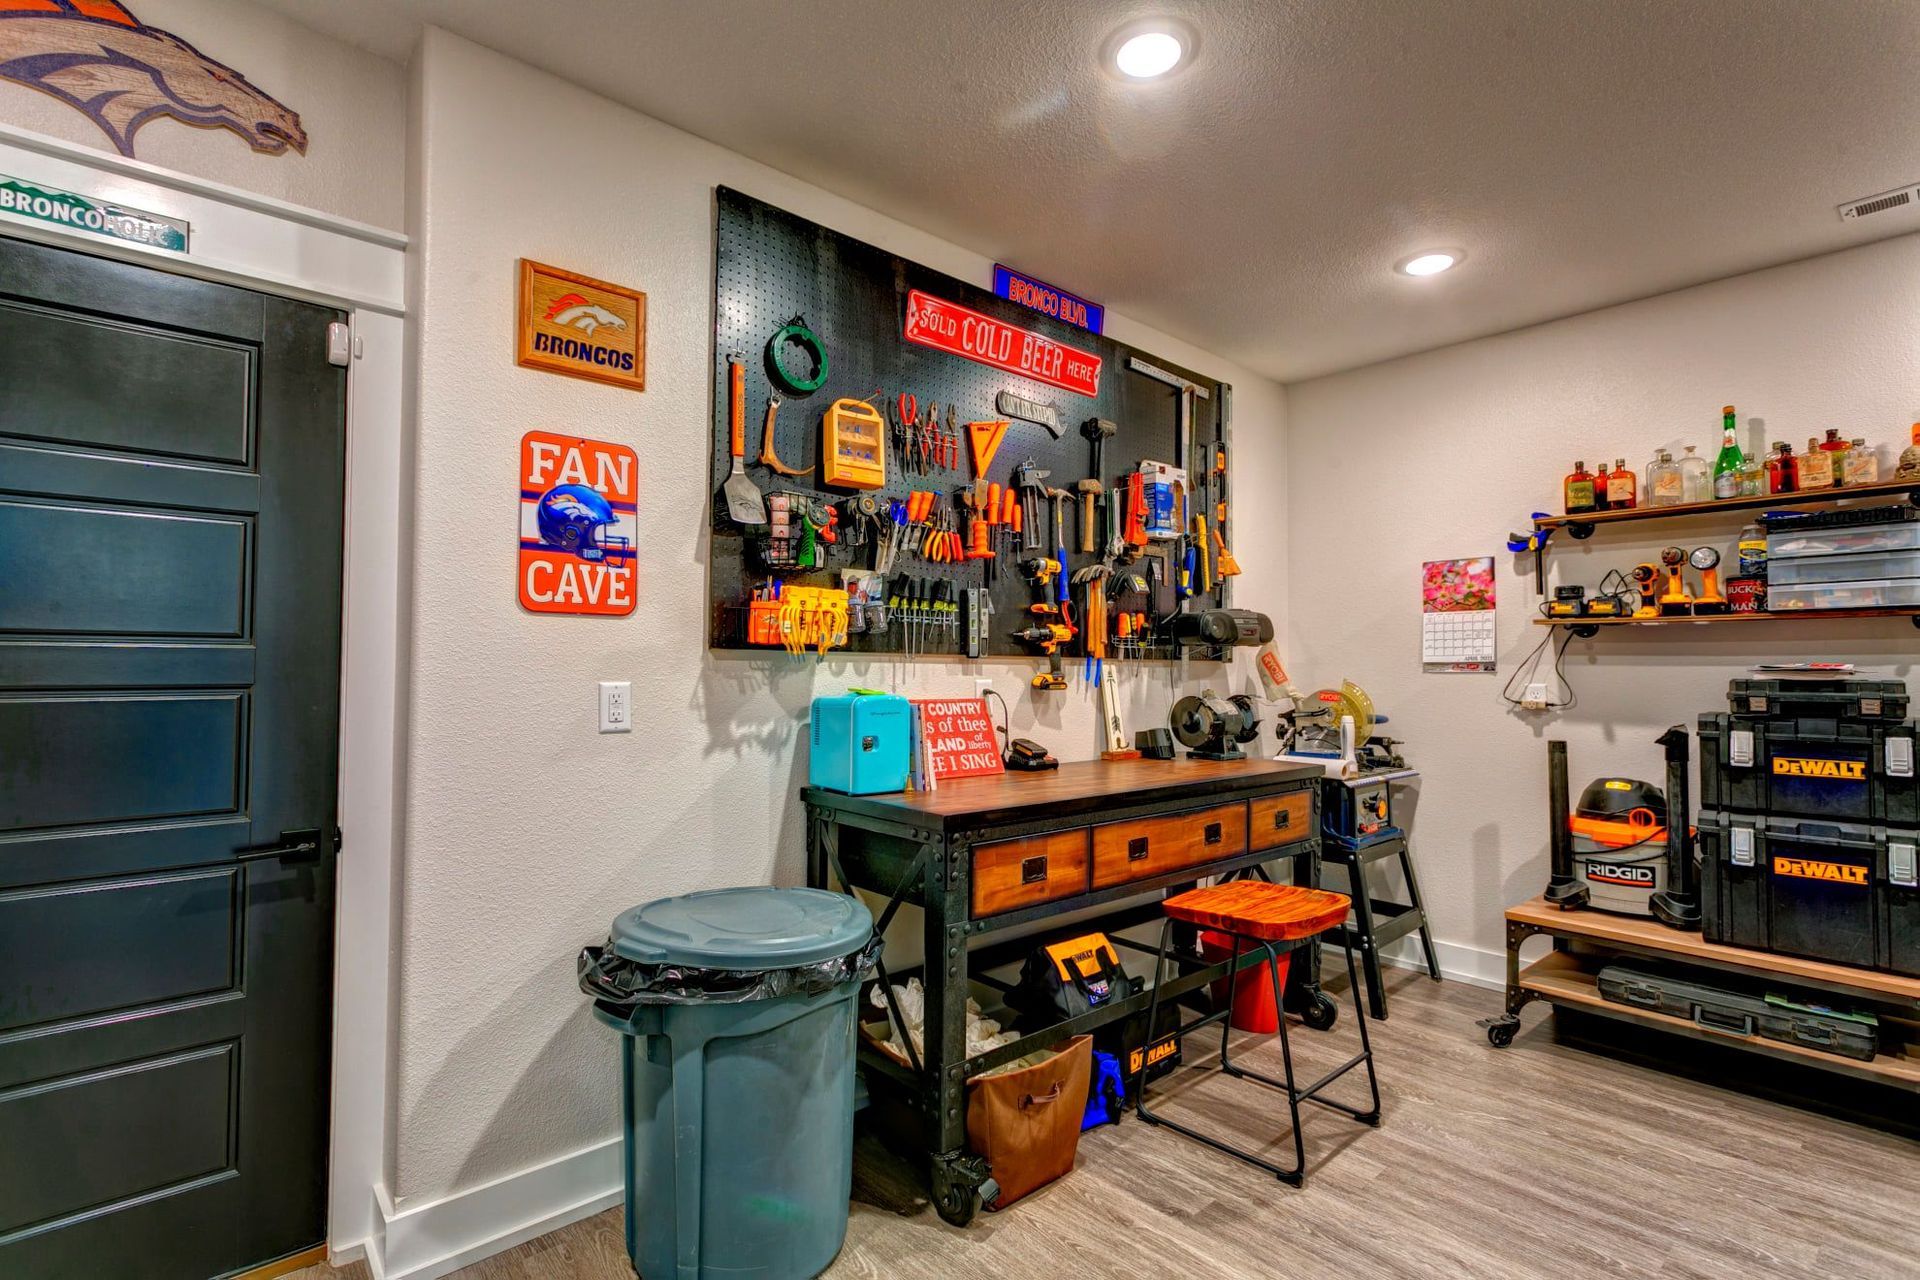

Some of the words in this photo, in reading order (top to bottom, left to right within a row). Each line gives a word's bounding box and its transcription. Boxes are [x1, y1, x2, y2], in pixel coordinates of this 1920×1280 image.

[1008, 276, 1058, 316] BRONCO
[1060, 298, 1089, 328] BLVD.
[534, 331, 634, 370] BRONCOS
[919, 307, 957, 337] SOLD
[962, 317, 1012, 362] COLD
[1020, 334, 1064, 379] BEER
[1067, 359, 1094, 383] HERE
[528, 440, 631, 497] FAN
[526, 559, 630, 607] CAVE
[1263, 653, 1287, 683] RYOBI
[927, 702, 981, 717] COUNTRY
[938, 716, 954, 733] of
[957, 717, 988, 732] thee
[967, 740, 992, 750] liberty
[974, 733, 984, 741] of
[950, 755, 958, 771] I
[960, 753, 997, 770] SING
[1587, 863, 1653, 881] RIDGID
